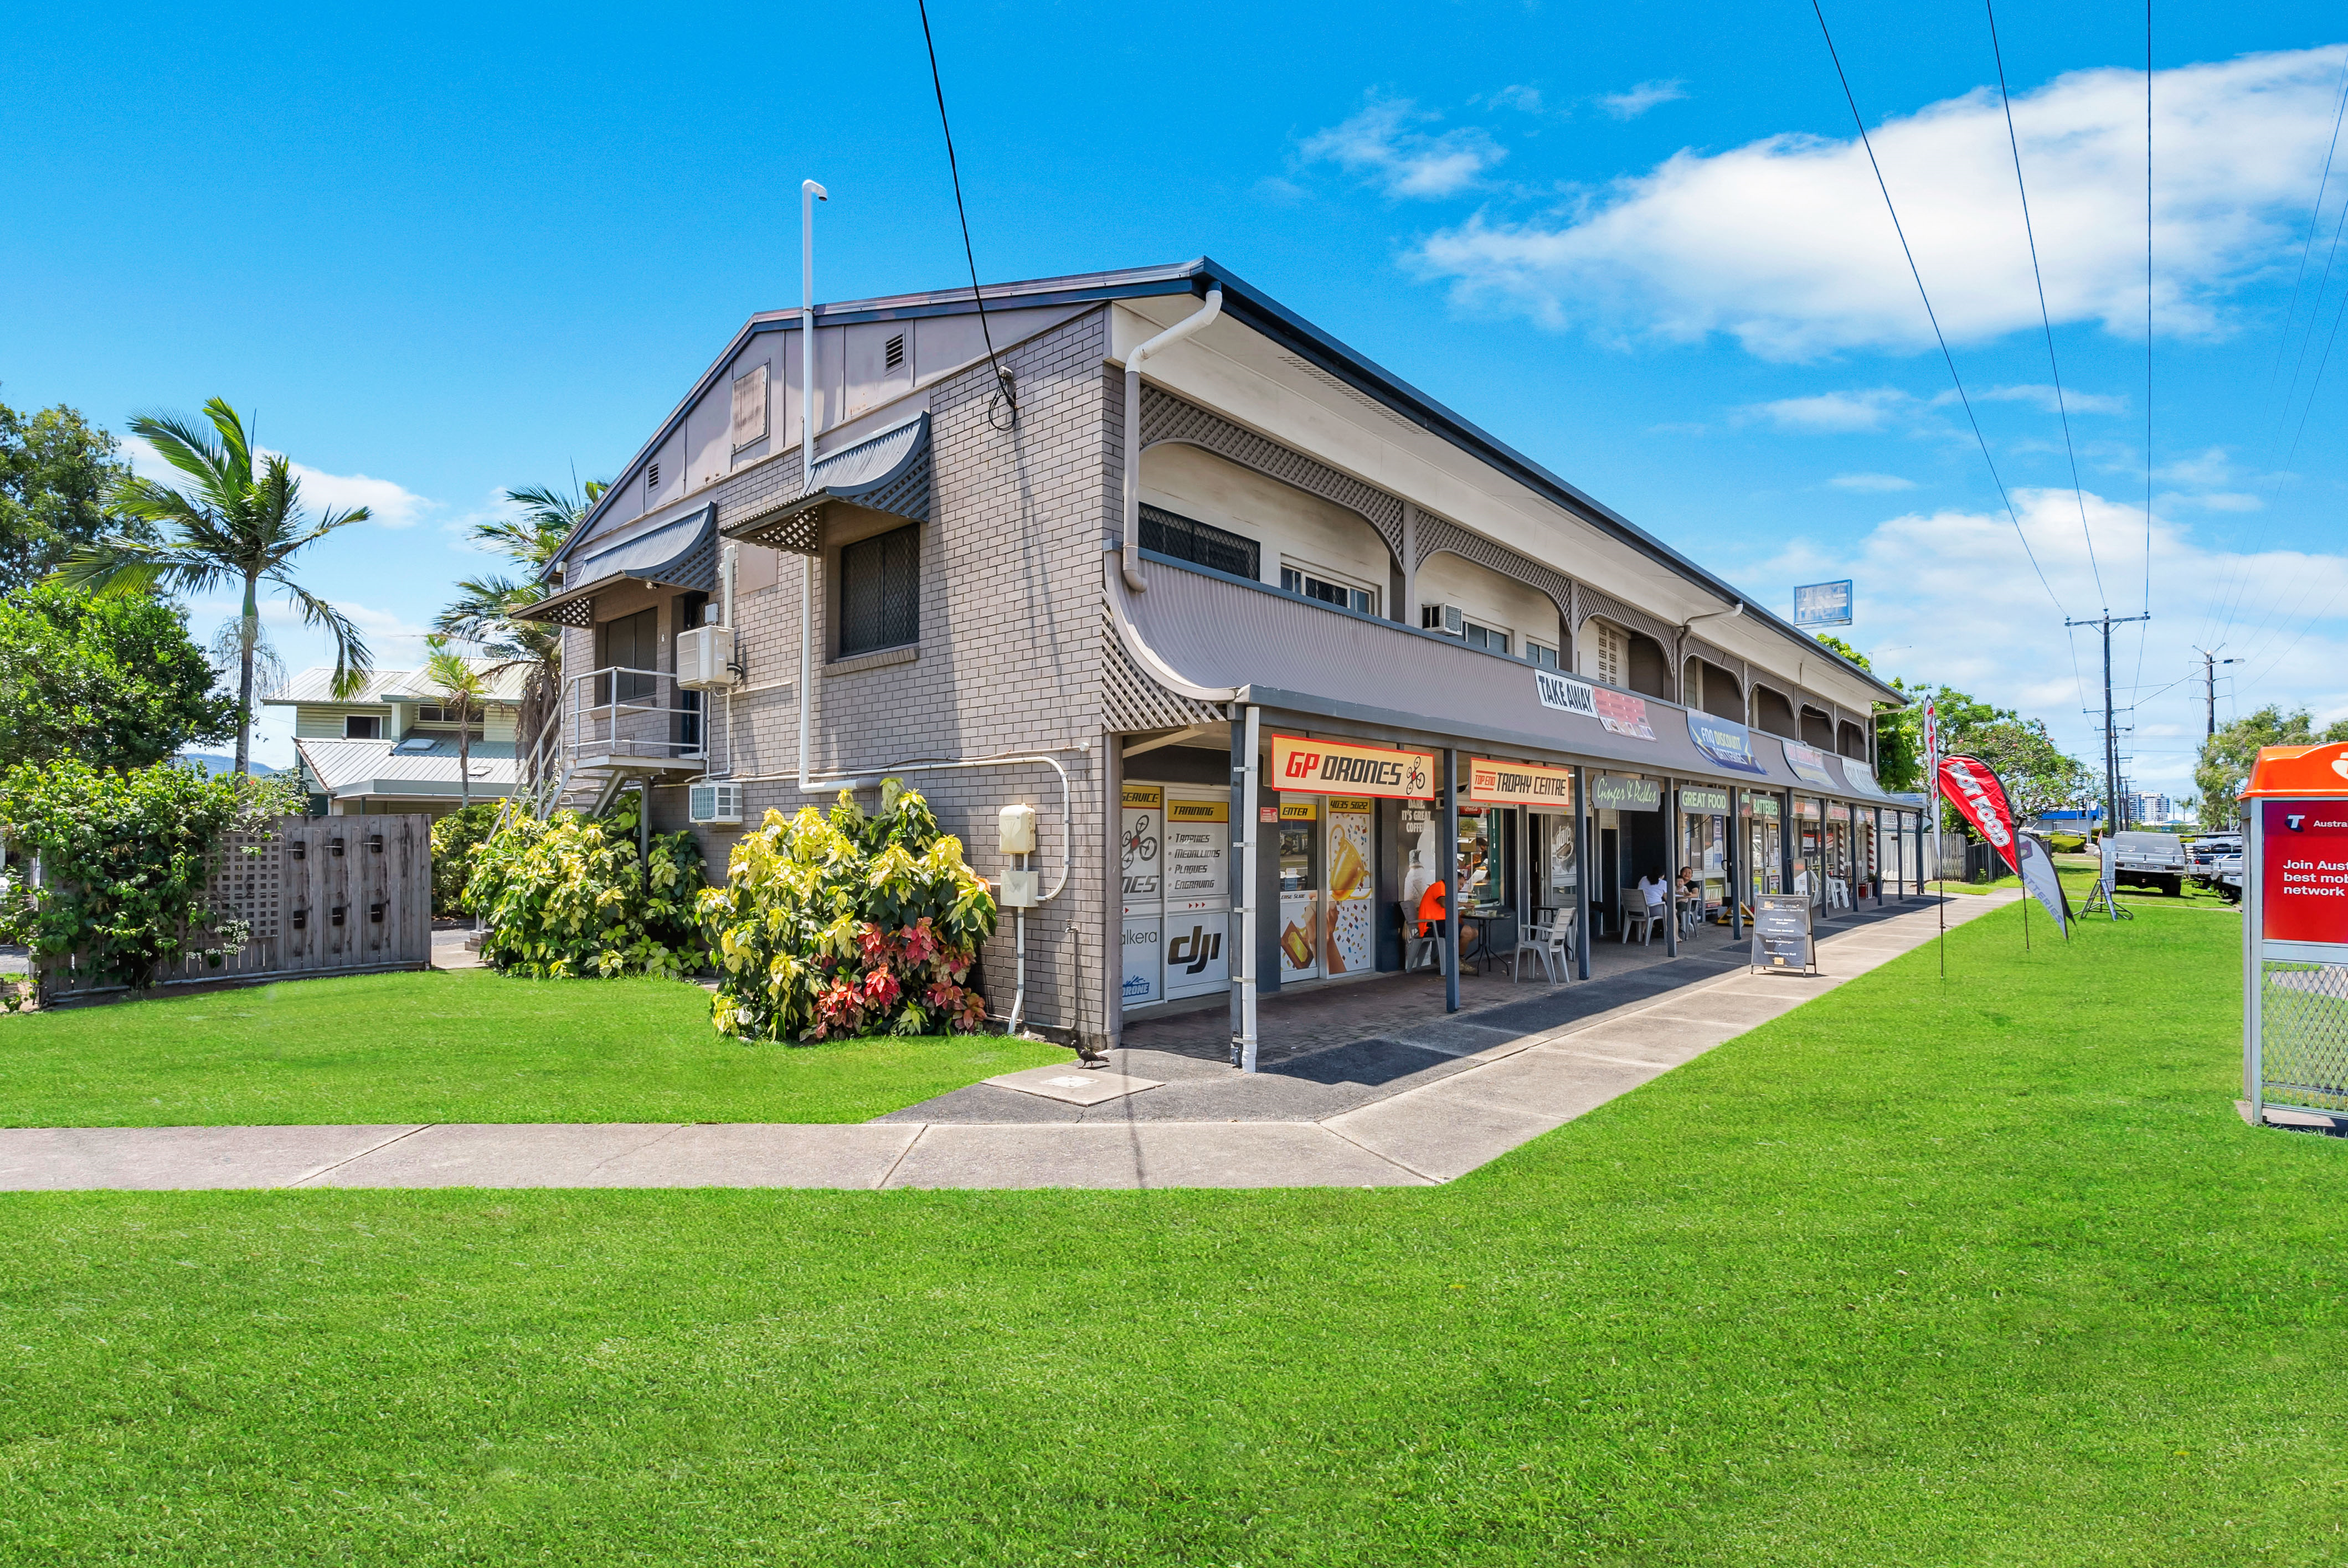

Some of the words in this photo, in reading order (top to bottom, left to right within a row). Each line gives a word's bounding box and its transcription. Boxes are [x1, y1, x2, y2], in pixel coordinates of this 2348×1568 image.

[1538, 675, 1568, 706] TAKE
[1567, 684, 1593, 713] AWAY
[1714, 731, 1742, 750] DISCOUNT
[1285, 751, 1320, 778] GP
[1320, 755, 1404, 785] DRONES
[1475, 775, 1485, 785] TOP
[1485, 776, 1495, 786] END
[1497, 772, 1532, 793] TROPHY
[1534, 776, 1567, 796] CENTRE
[1122, 792, 1159, 802] SERVICE
[1597, 778, 1625, 808] Ginger
[1634, 780, 1657, 804] Pickles
[1408, 799, 1425, 809] DARE.
[1682, 791, 1706, 807] GREAT
[1708, 793, 1726, 809] FOOD
[1947, 761, 1984, 797] HOT
[1970, 796, 2011, 847] FOOD
[1173, 806, 1214, 816] TRAINING
[1282, 807, 1307, 816] ENTER
[1753, 798, 1778, 816] BATTERIES
[1402, 809, 1412, 821] IT'S
[1413, 811, 1431, 821] GREAT
[2283, 860, 2313, 869] Join
[2284, 872, 2316, 882] best
[2283, 886, 2345, 896] network
